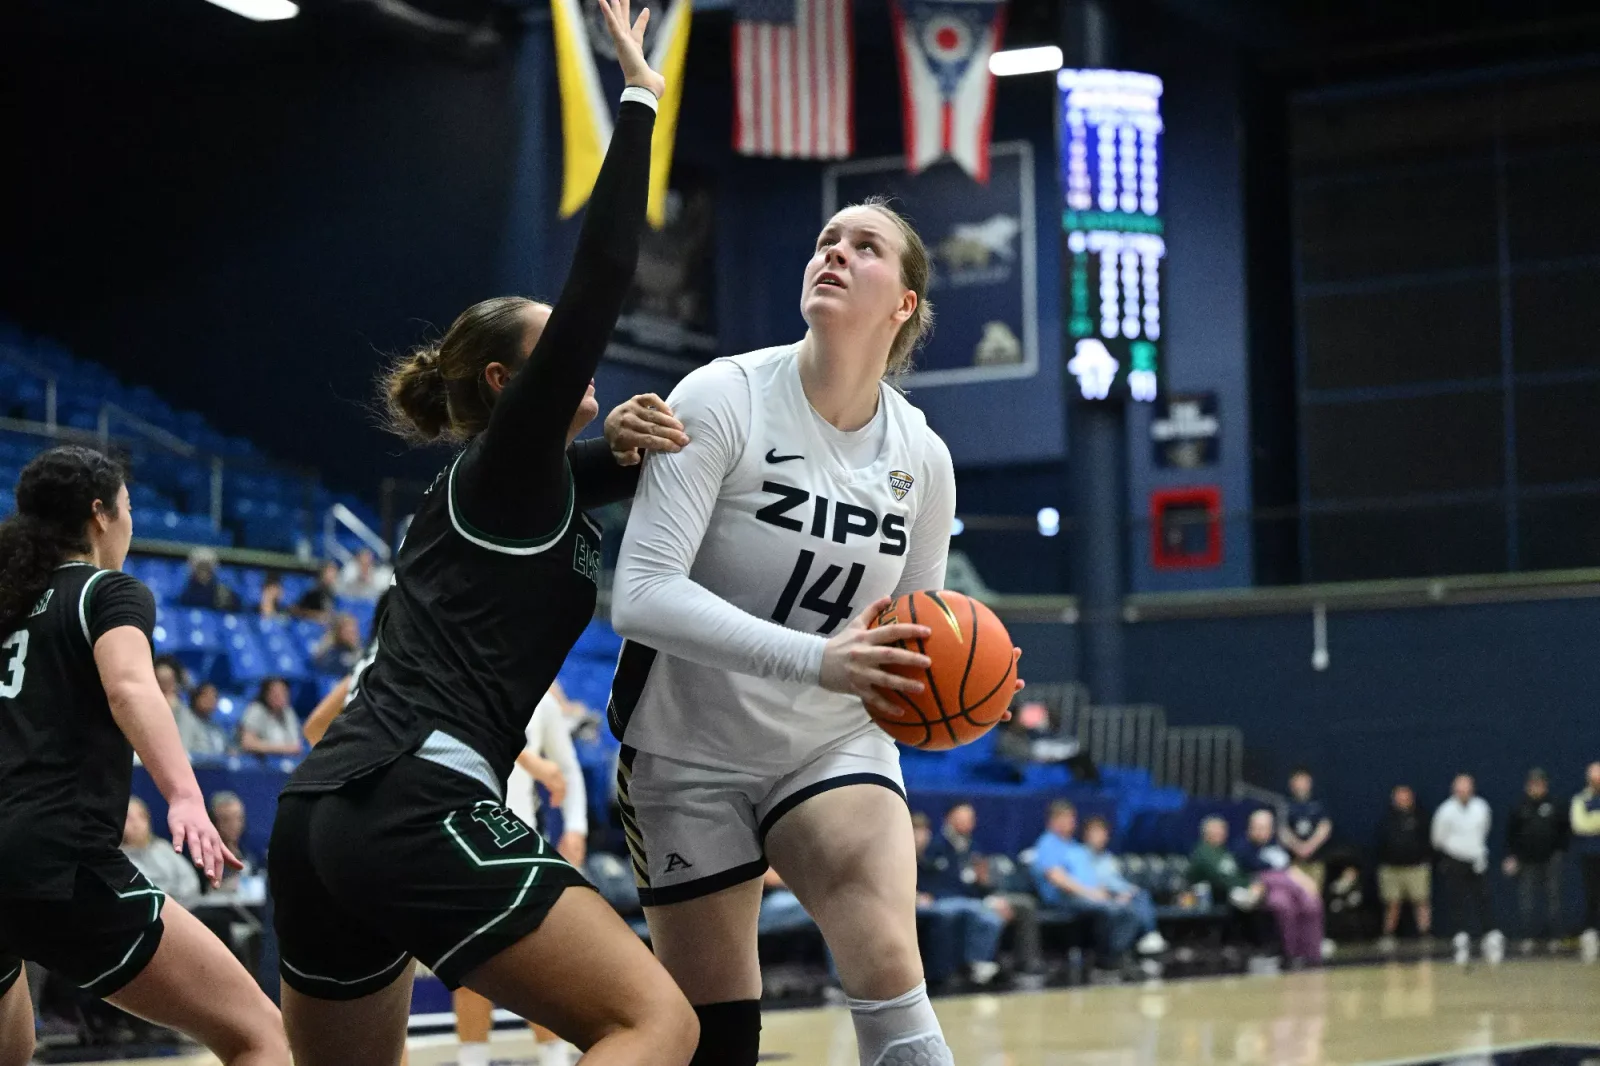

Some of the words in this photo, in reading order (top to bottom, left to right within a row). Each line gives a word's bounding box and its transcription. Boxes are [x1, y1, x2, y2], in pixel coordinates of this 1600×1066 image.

[755, 480, 907, 556] ZIPS
[771, 549, 866, 635] 14
[470, 806, 530, 849] E
[664, 852, 693, 873] A
